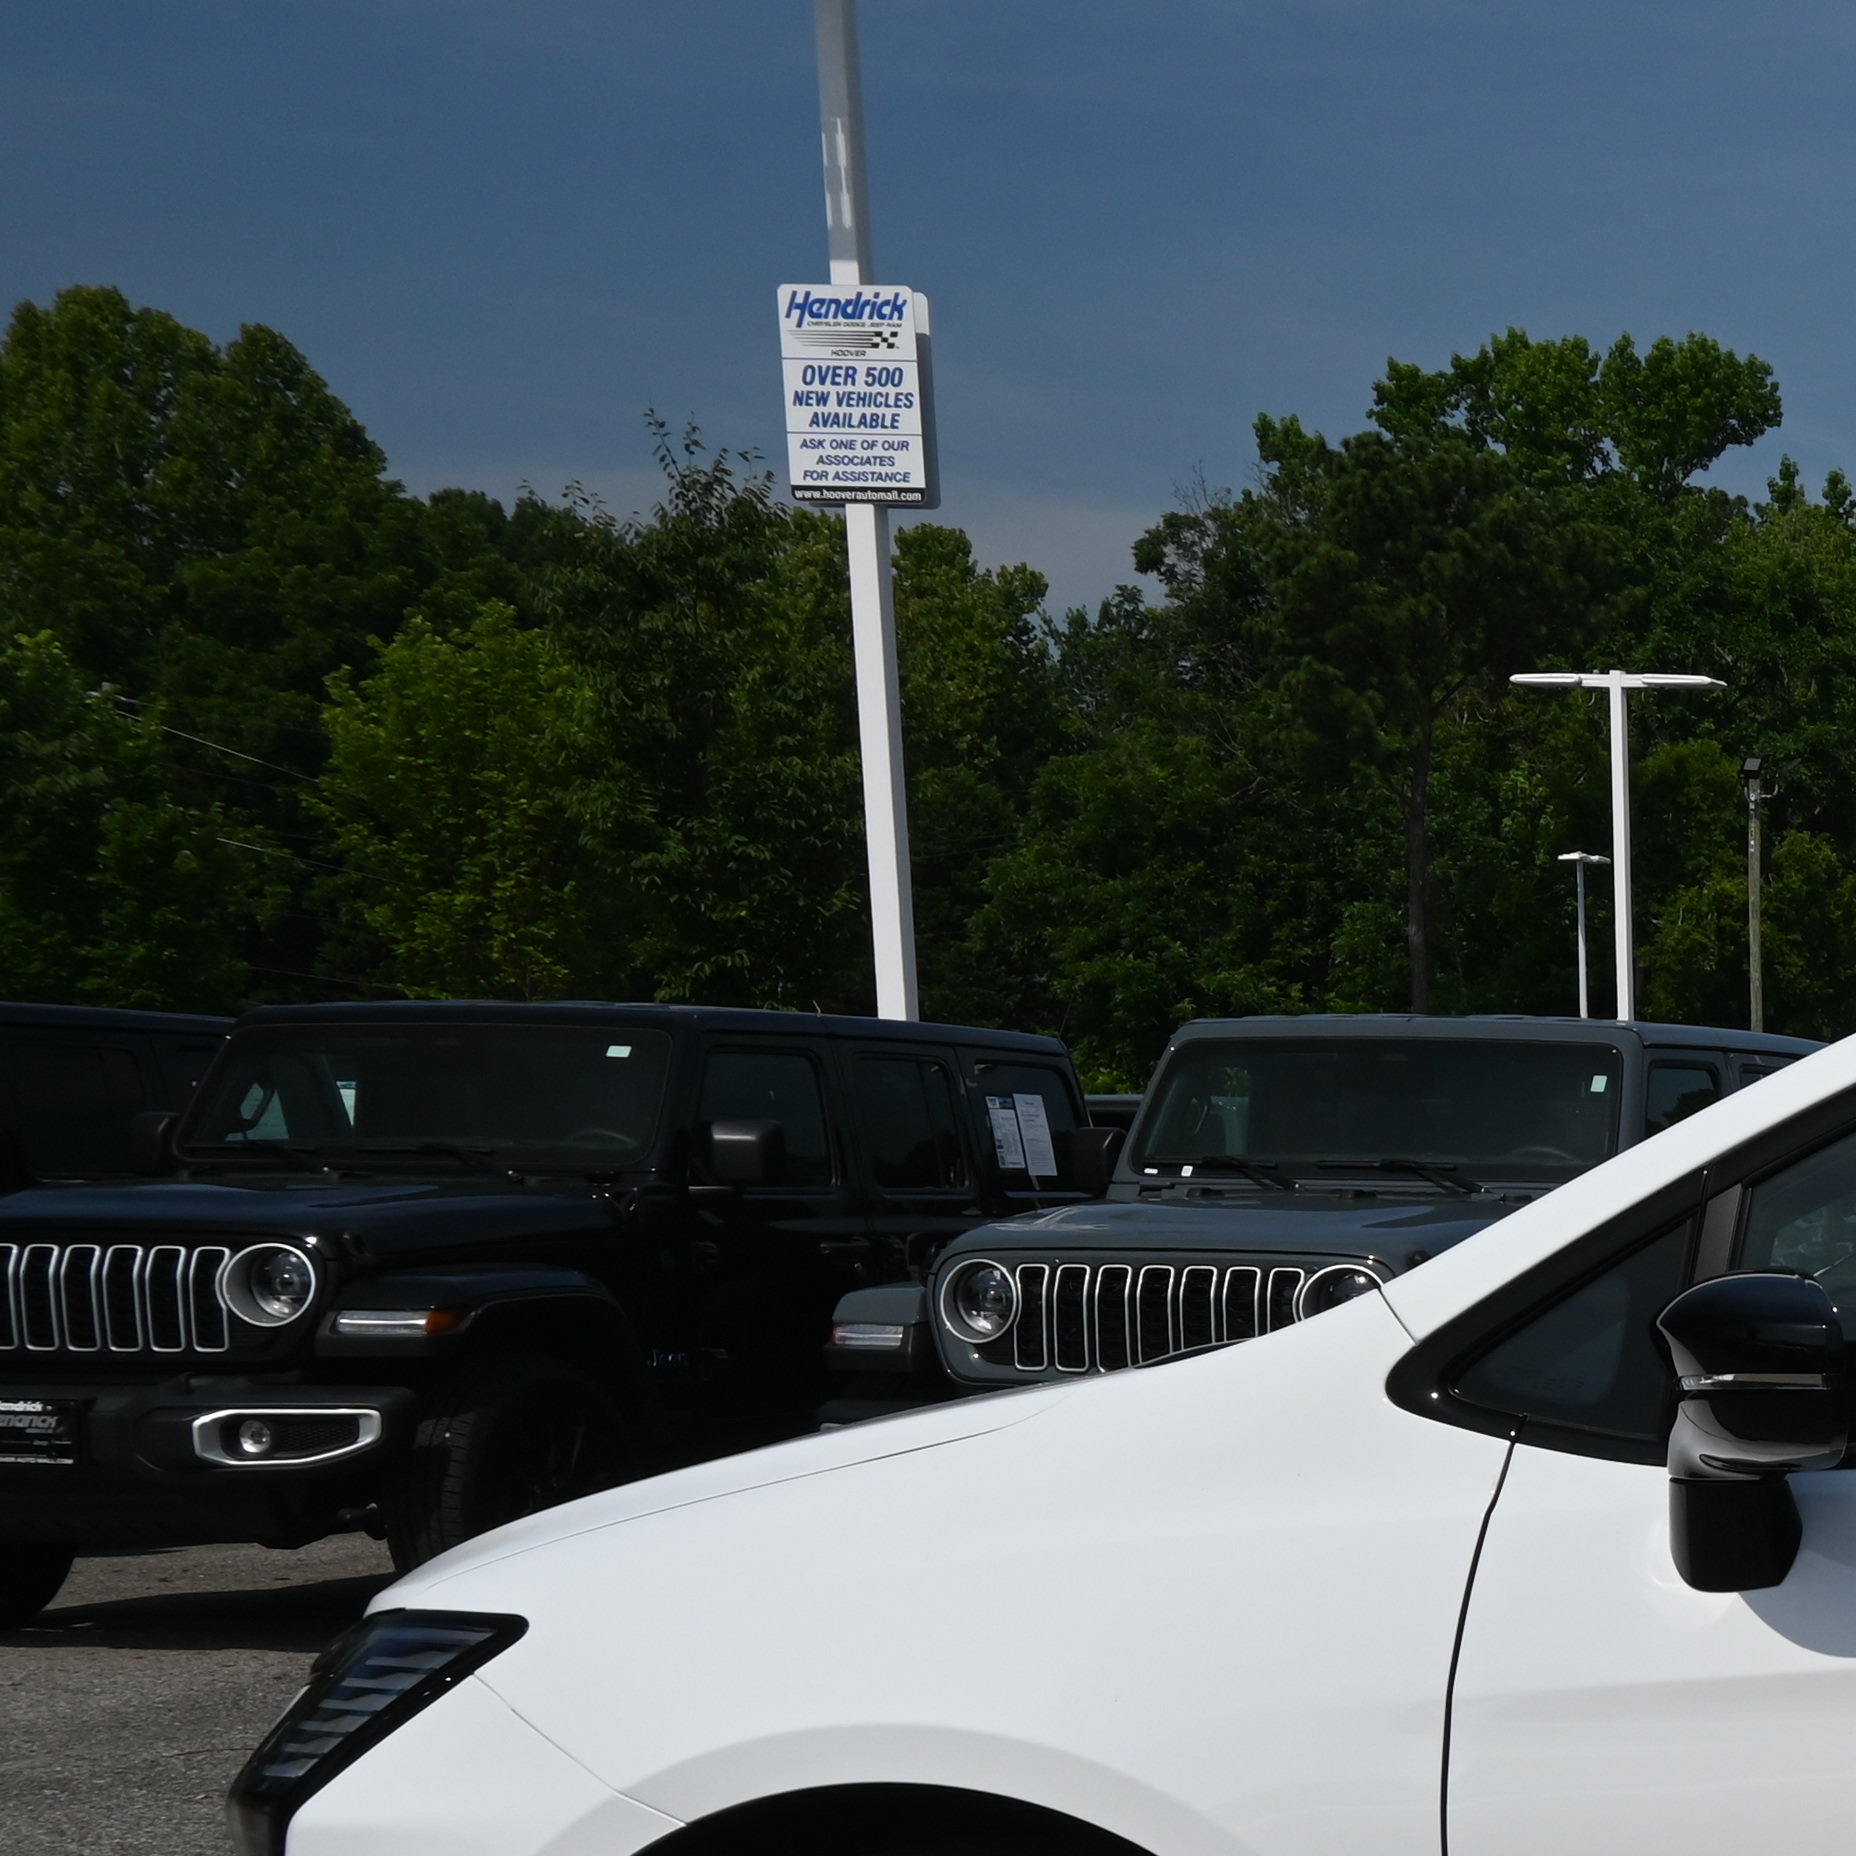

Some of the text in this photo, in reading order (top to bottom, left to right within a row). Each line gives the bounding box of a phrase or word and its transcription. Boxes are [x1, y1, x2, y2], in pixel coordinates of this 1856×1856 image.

[785, 290, 907, 328] Hendrick
[830, 349, 867, 357] HOOVER
[802, 365, 904, 387] OVER 500
[792, 390, 914, 409] NEW VEHICLES
[809, 412, 900, 430] AVAILABLE
[800, 439, 910, 451] ASK ONE OF OUR
[816, 455, 895, 467] ASSOCIATES
[803, 470, 911, 483] FOR ASSISTANCE
[794, 488, 922, 501] www.hooverautomall.com
